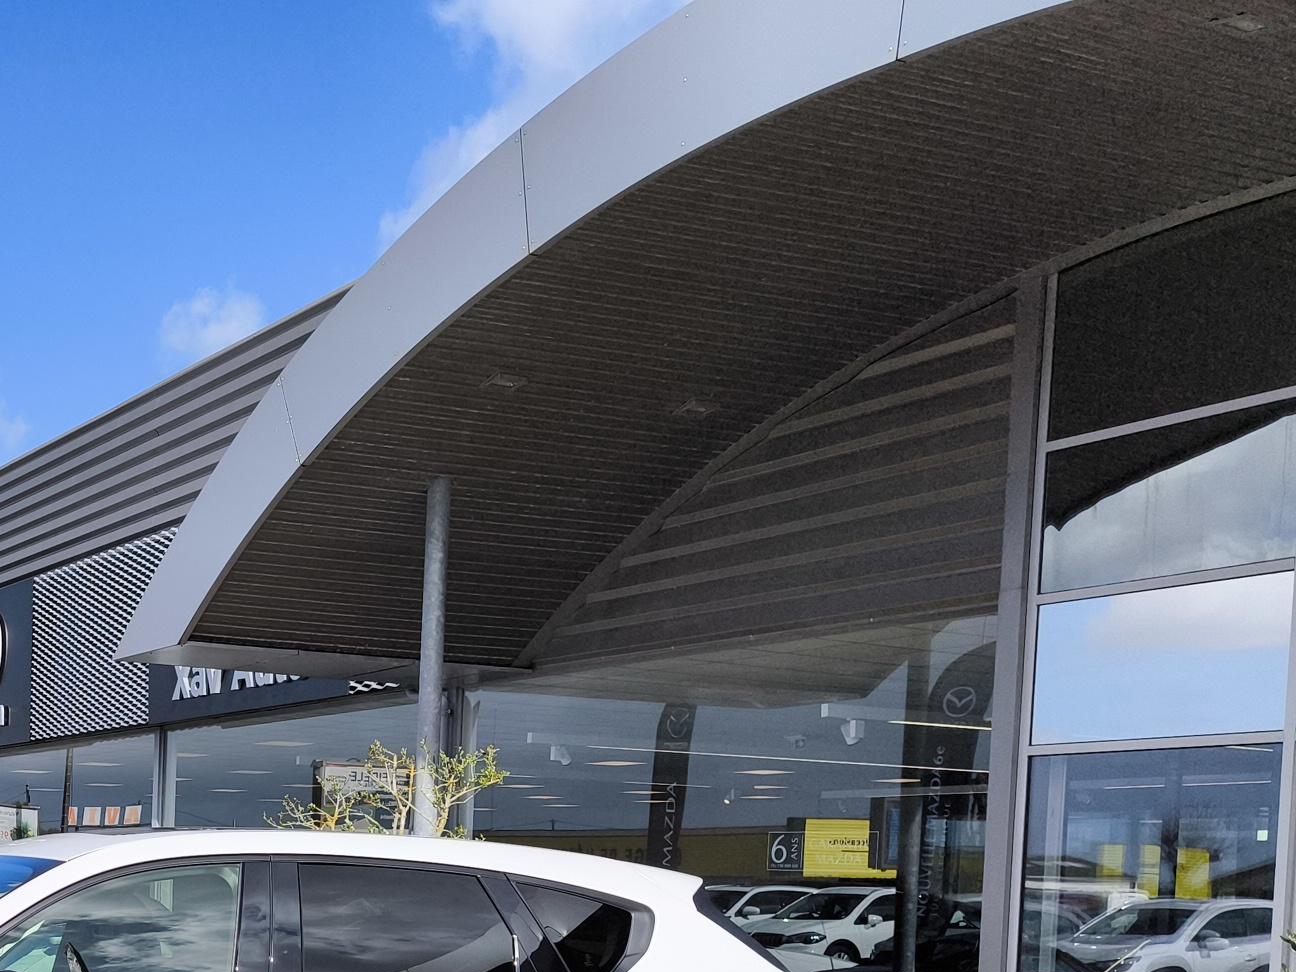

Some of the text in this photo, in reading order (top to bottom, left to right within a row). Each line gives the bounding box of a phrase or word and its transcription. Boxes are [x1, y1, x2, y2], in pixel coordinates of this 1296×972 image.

[172, 664, 301, 700] Xav Au
[662, 782, 676, 866] MAZDA
[771, 834, 787, 864] 6
[790, 837, 799, 860] ANS
